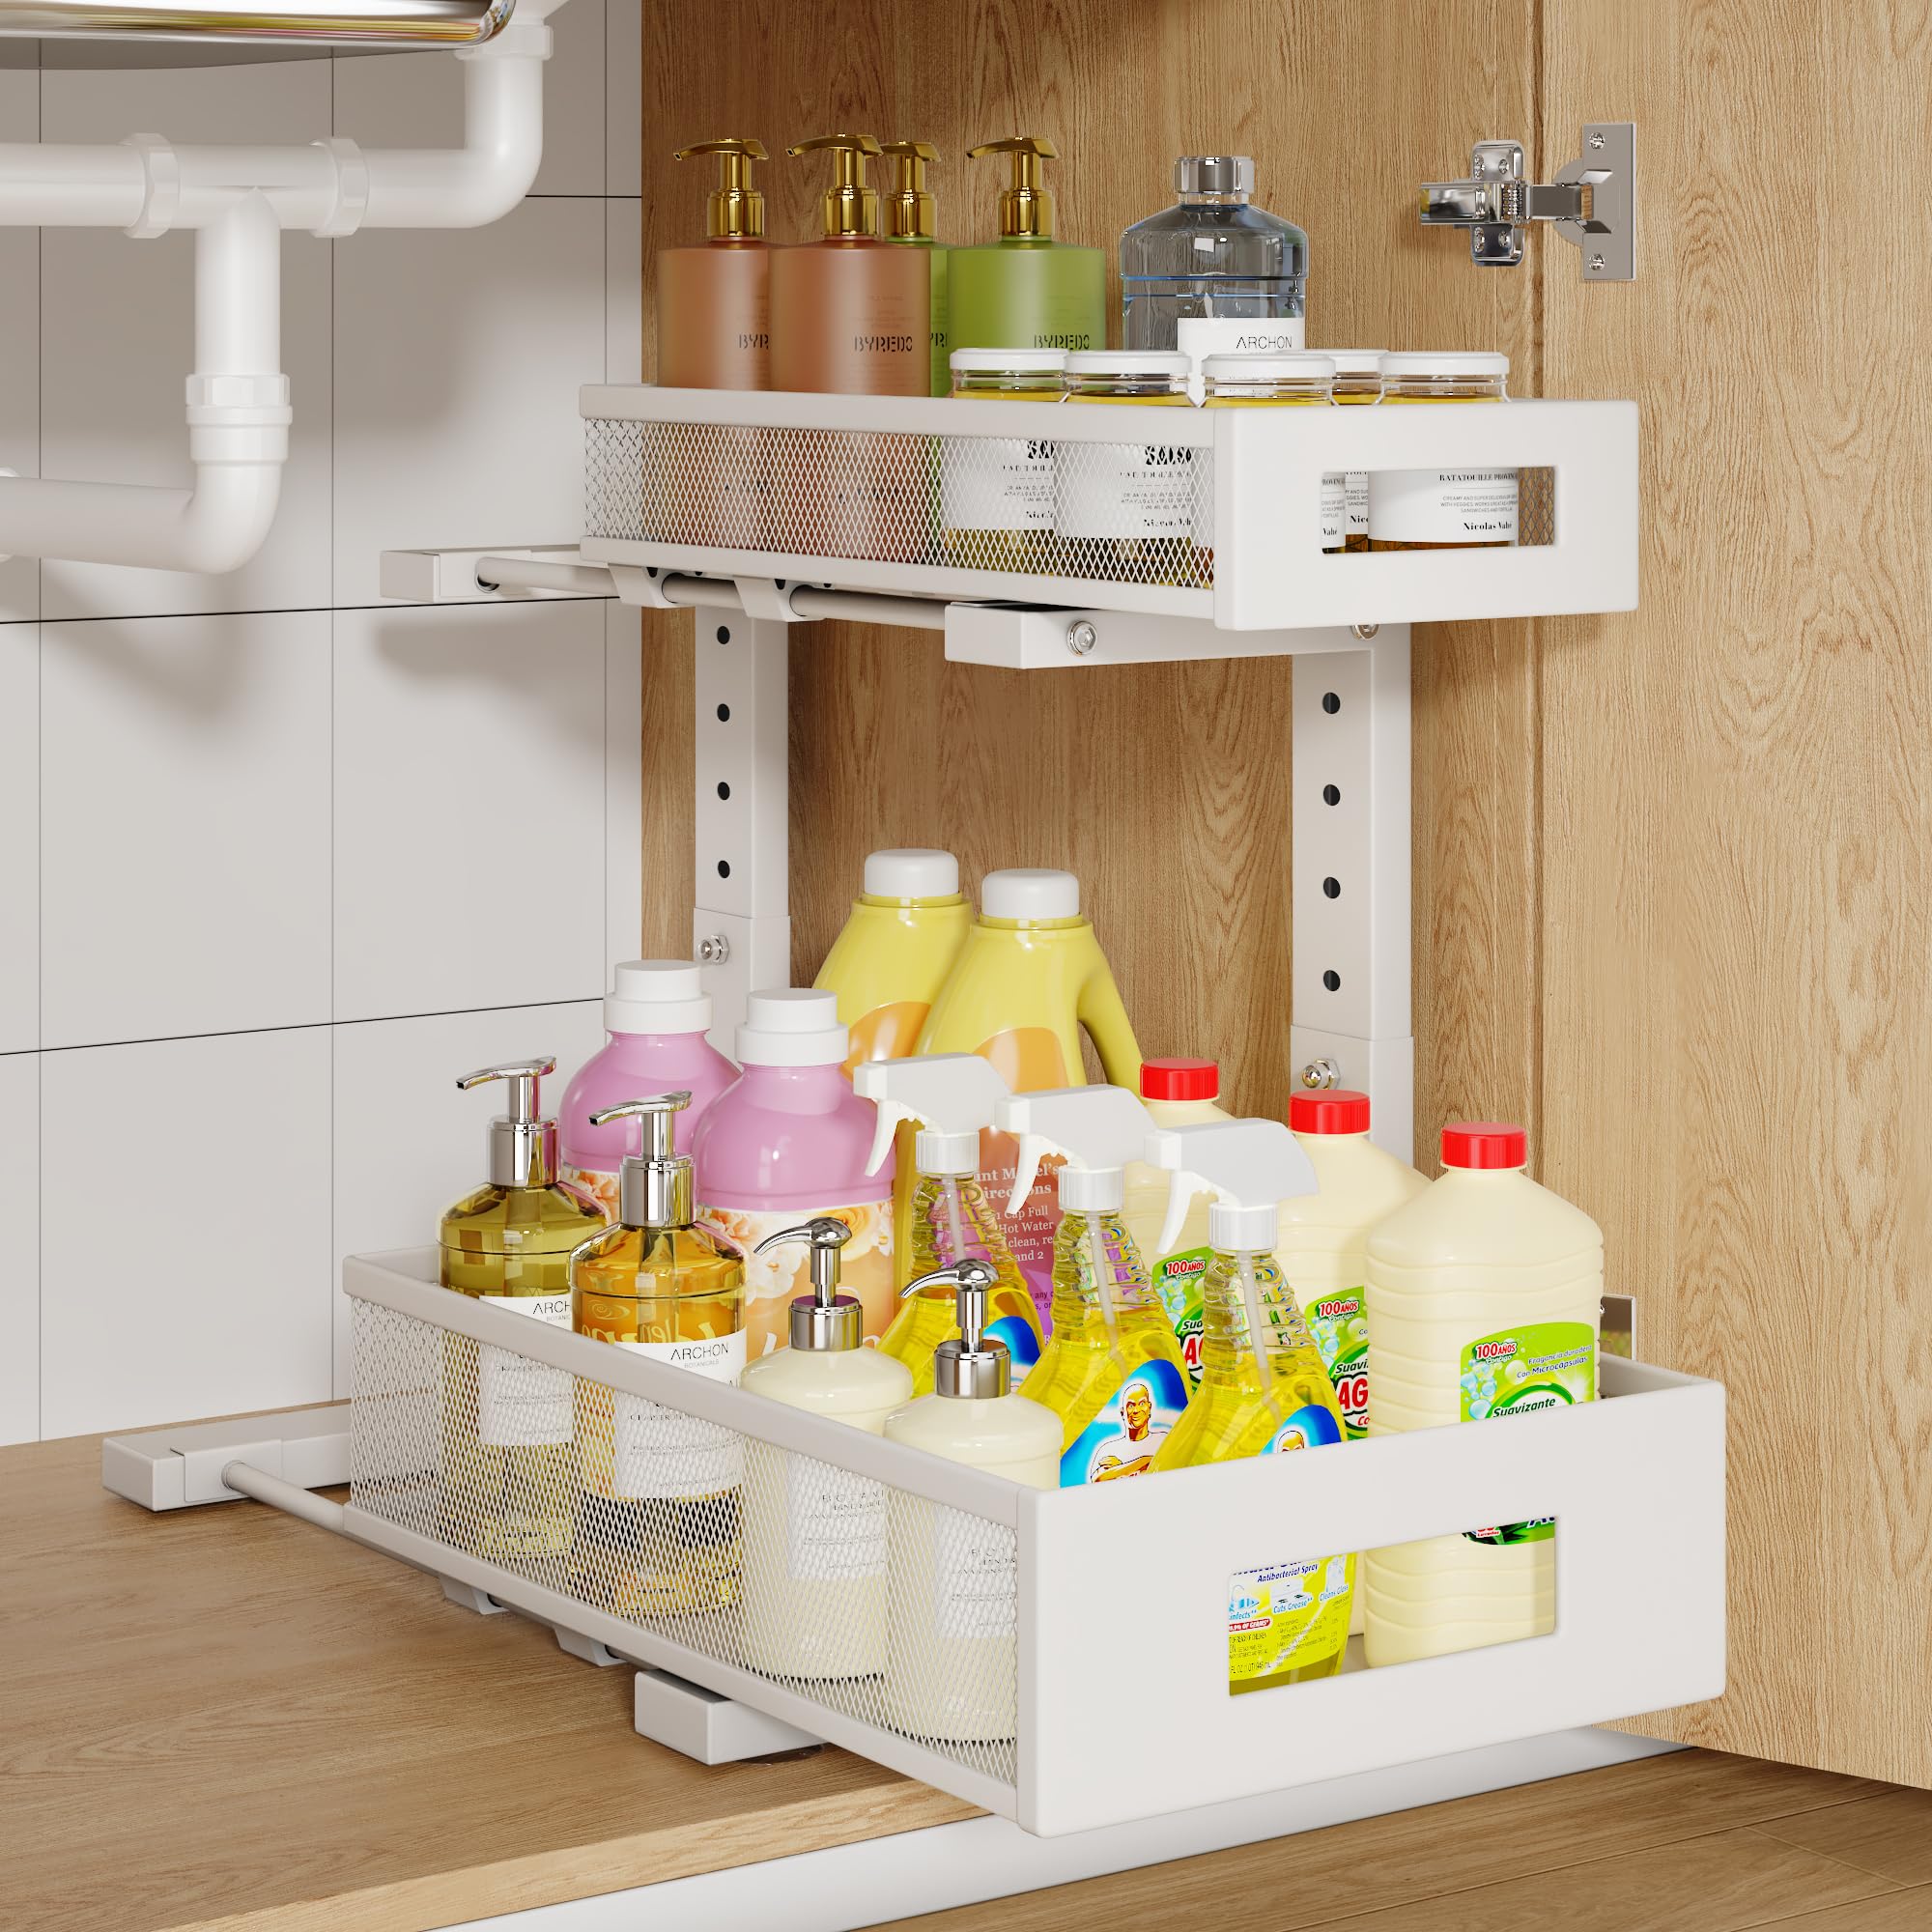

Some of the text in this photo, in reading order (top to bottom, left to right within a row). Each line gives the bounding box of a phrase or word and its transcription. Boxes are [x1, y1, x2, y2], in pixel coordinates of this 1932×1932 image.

[854, 335, 913, 353] BYREDO
[1034, 334, 1090, 350] BYREDO
[1236, 335, 1293, 349] ARCHON
[1463, 522, 1496, 530] Nicolas
[1028, 1206, 1048, 1217] Full
[1021, 1221, 1054, 1232] Water
[1009, 1236, 1039, 1248] clean,
[1037, 1251, 1044, 1260] 2
[670, 1343, 729, 1361] ARCHON
[1528, 1352, 1563, 1364] Fragancia
[1335, 1359, 1369, 1374] Suavi
[1517, 1370, 1531, 1378] Con
[1492, 1397, 1556, 1418] Suavizante
[1257, 1567, 1300, 1582] Antibacterial
[1301, 1563, 1319, 1575] Spray
[1273, 1604, 1287, 1613] Cuts
